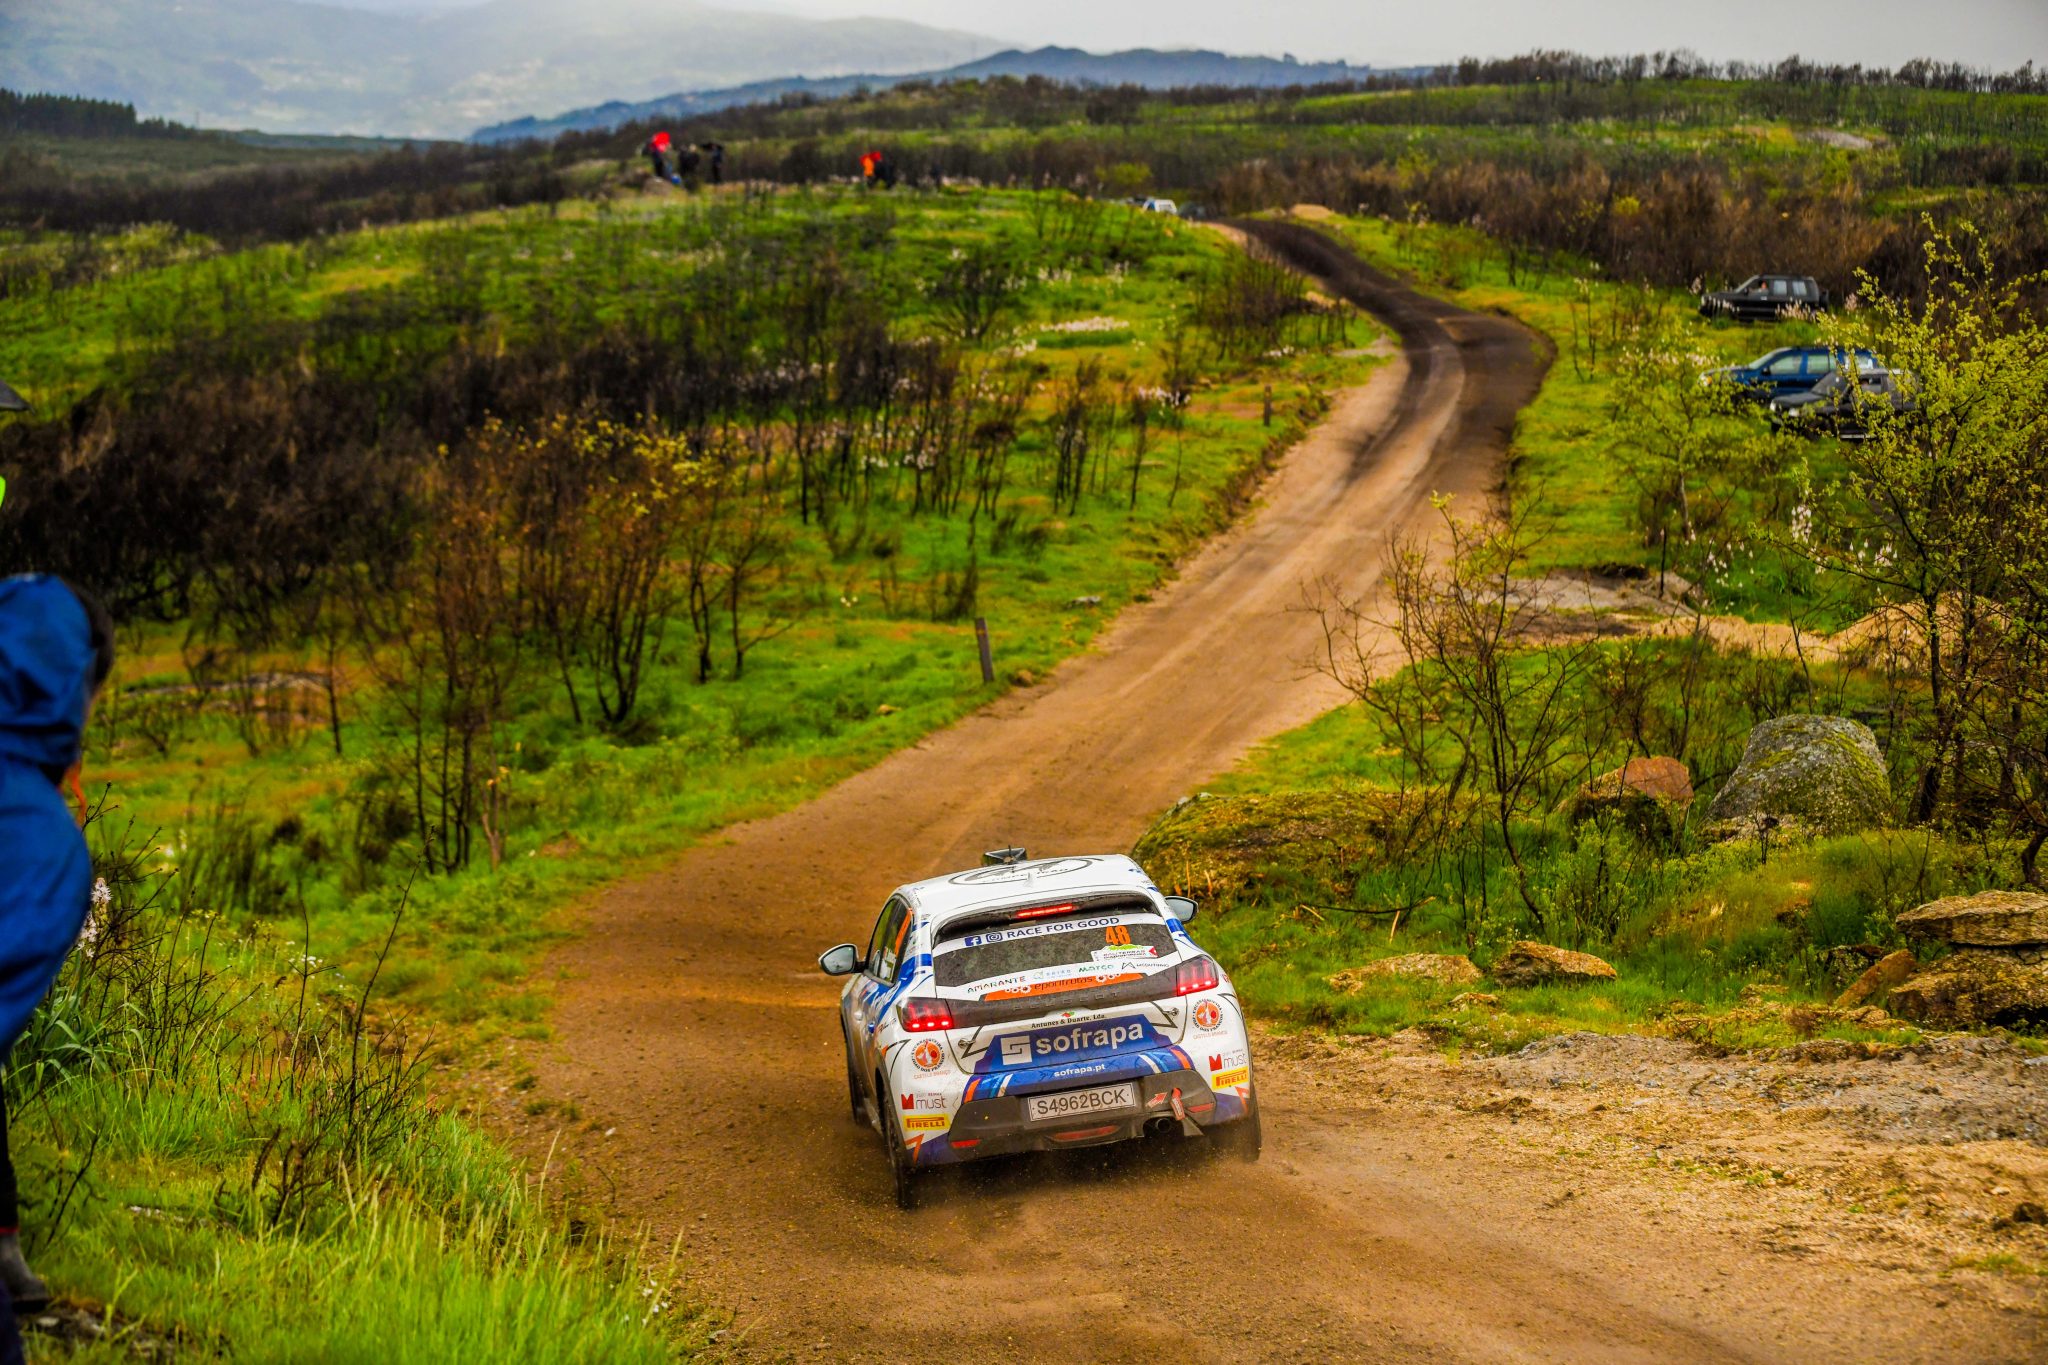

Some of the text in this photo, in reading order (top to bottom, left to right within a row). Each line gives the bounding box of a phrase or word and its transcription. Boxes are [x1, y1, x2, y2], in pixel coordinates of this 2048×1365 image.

[1006, 917, 1120, 938] RACE FOR GOOD
[1105, 925, 1131, 945] 48
[967, 976, 1026, 994] AMARANTE
[1031, 1020, 1058, 1028] Antunes
[1036, 1023, 1144, 1054] sofrapa
[1223, 1054, 1247, 1069] must
[1054, 1064, 1105, 1077] sofrapa.pt
[1216, 1070, 1247, 1086] PIRELLI
[915, 1096, 947, 1109] must
[1037, 1088, 1126, 1114] S4962BCK
[906, 1117, 945, 1128] PIRELLI
